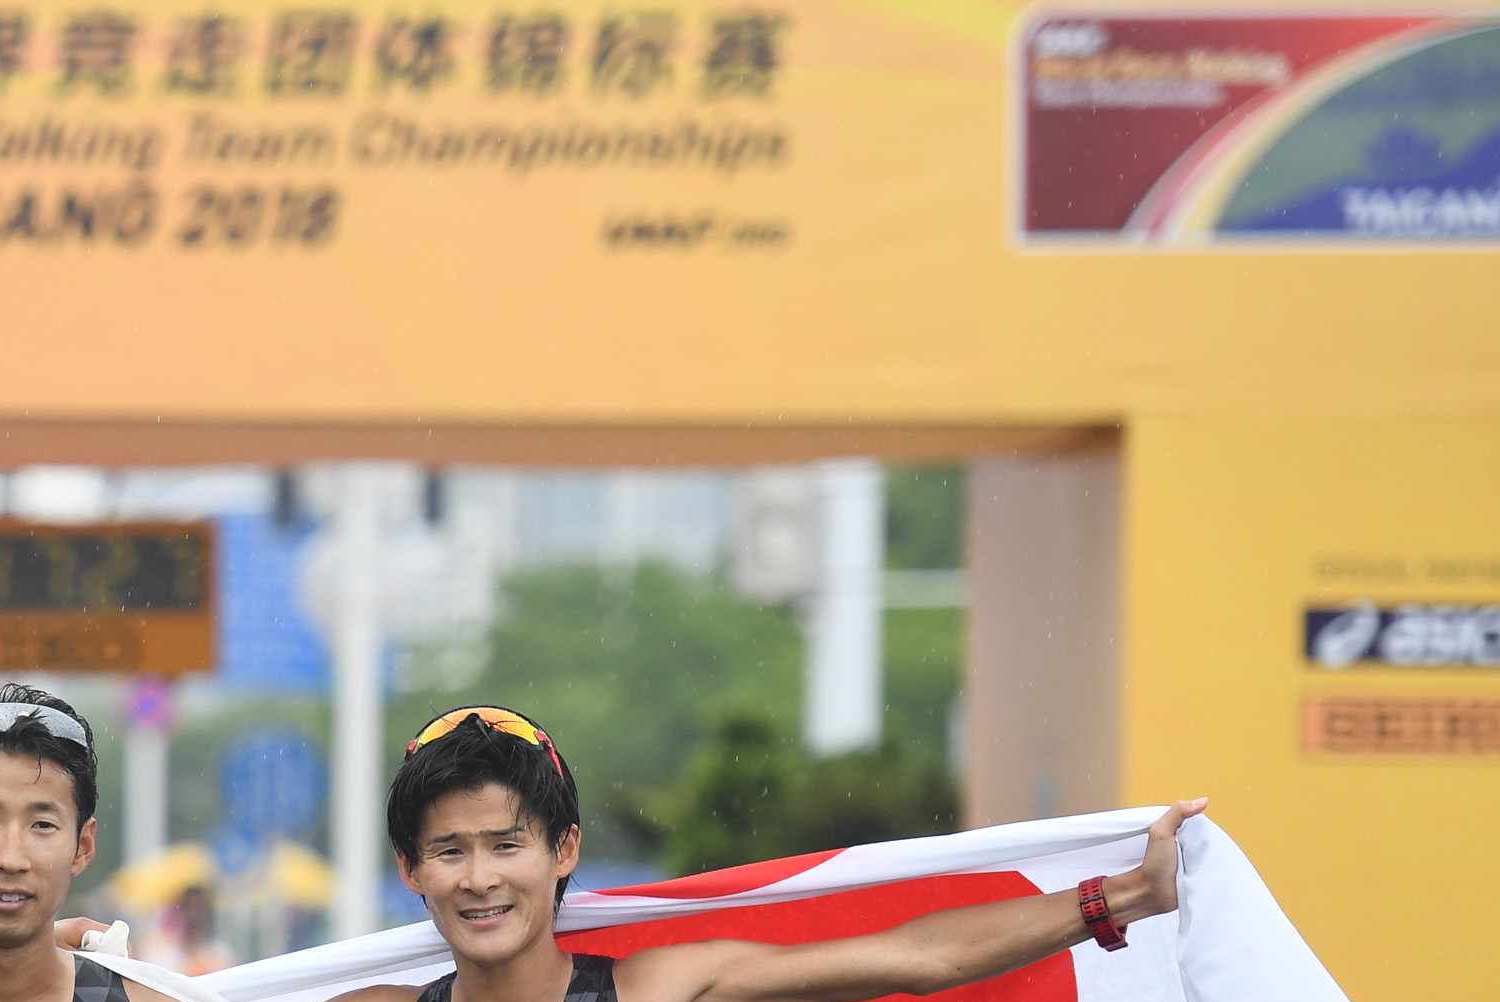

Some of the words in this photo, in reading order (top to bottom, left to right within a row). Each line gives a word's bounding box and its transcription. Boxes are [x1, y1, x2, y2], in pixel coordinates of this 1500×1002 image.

[180, 114, 336, 163] Team
[350, 112, 792, 178] Championships
[176, 186, 342, 250] 2018
